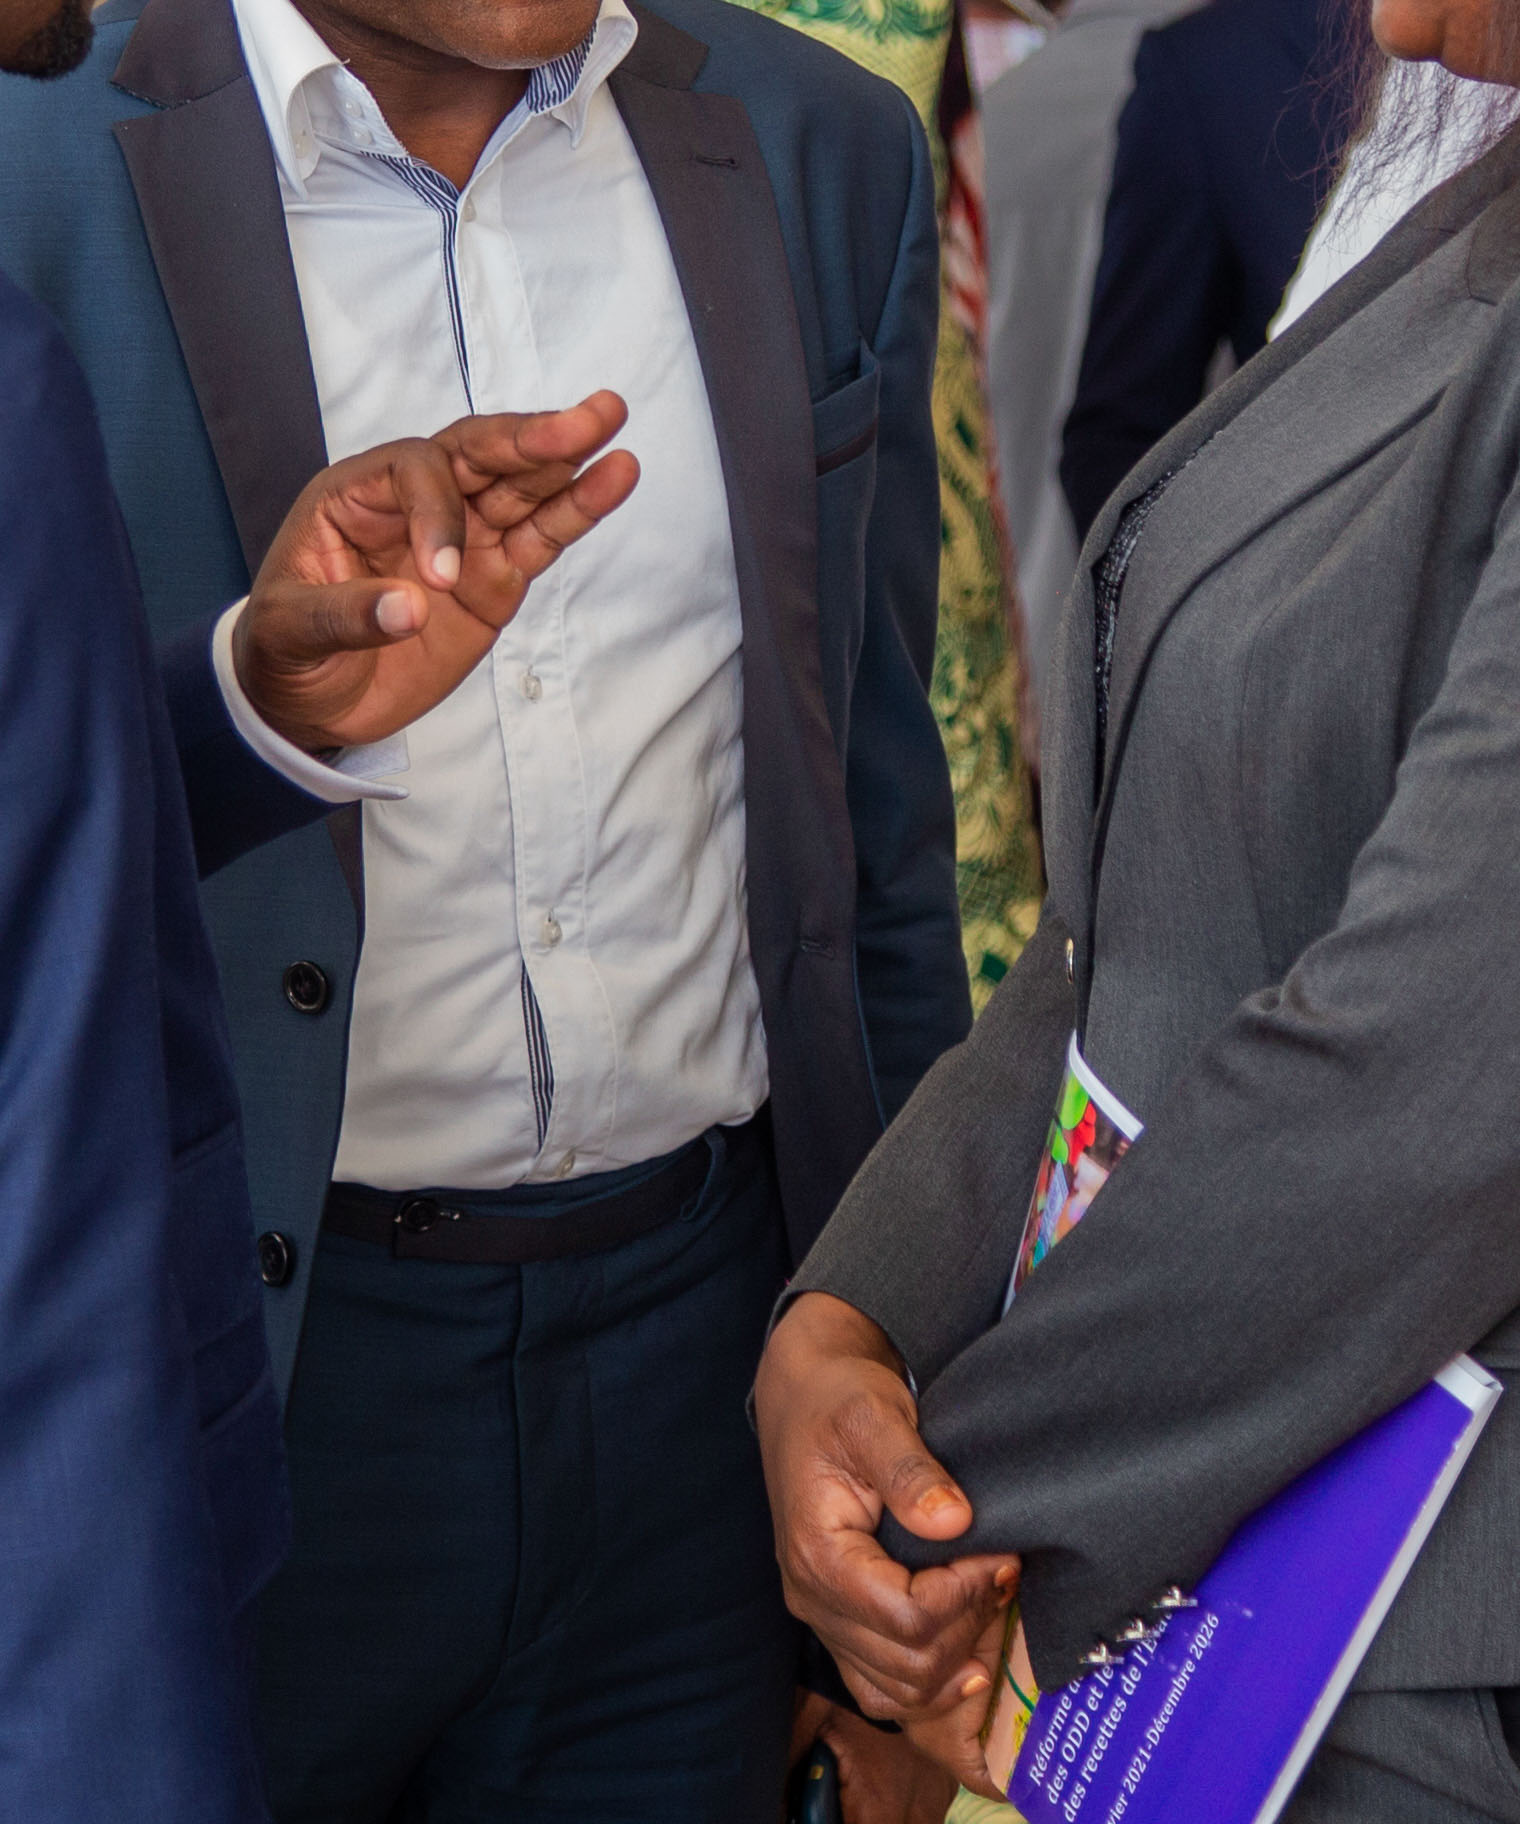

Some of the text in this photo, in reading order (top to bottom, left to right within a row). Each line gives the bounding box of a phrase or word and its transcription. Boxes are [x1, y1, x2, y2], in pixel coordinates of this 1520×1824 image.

[1030, 1695, 1073, 1787] Réforme
[1047, 1764, 1069, 1805] des
[1061, 1712, 1090, 1764] ODD
[1087, 1684, 1104, 1712] et
[1062, 1783, 1086, 1824] des
[1080, 1695, 1127, 1784] recettes
[1120, 1665, 1142, 1696] de
[1122, 1659, 1196, 1796] 2021-Décembre
[1189, 1612, 1220, 1661] 2026
